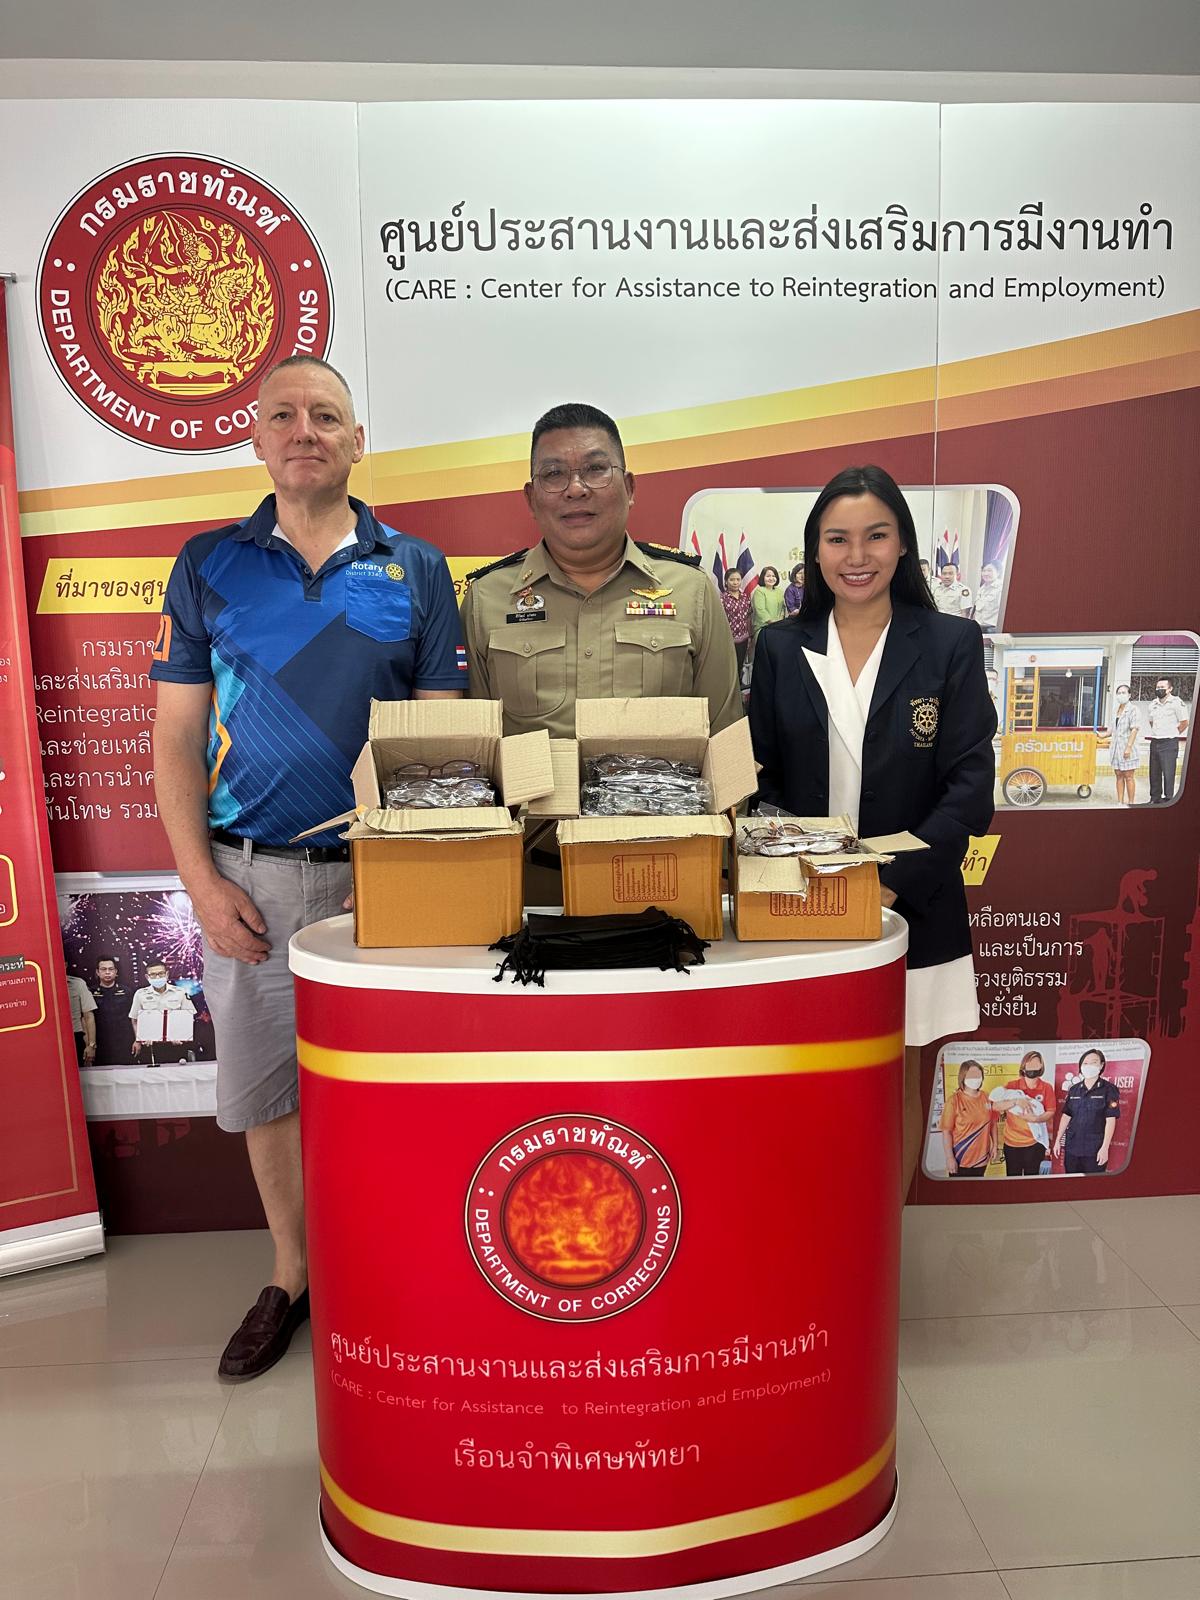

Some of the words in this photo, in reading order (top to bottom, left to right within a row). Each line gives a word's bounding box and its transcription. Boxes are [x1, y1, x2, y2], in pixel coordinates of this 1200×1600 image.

[80, 168, 291, 237] กรมราชทัณฑ์
[380, 201, 1173, 271] ศูนย์ประสานงานและส่งเสริมการมีงานทำ
[385, 278, 456, 302] (CARE
[481, 279, 562, 299] Center
[572, 277, 606, 298] for
[615, 277, 740, 298] Assistance
[750, 277, 774, 297] to
[783, 277, 937, 302] Reintegration
[949, 277, 994, 299] and
[1004, 275, 1165, 302] Employment)
[51, 289, 160, 432] DEPARTMENT
[171, 420, 203, 439] OF
[351, 561, 384, 572] Rotary
[979, 933, 1084, 957] และเป็นการ
[498, 1124, 653, 1172] กรมราชทัณฑ์
[475, 1208, 551, 1308] DEPARTMENT
[558, 1299, 582, 1312] OF
[591, 1204, 671, 1310] CORRECTIONS
[331, 1322, 829, 1379] ศูนย์ประสานงานและส่งเสริมการมีงานทำ
[376, 1390, 426, 1409] Center
[432, 1398, 456, 1411] for
[460, 1399, 544, 1415] Assistance
[561, 1402, 578, 1415] to
[585, 1397, 691, 1417] Reintegration
[697, 1390, 727, 1406] and
[732, 1368, 832, 1401] Employment)
[454, 1438, 701, 1471] เรือนจำพิเศษพัทยา
